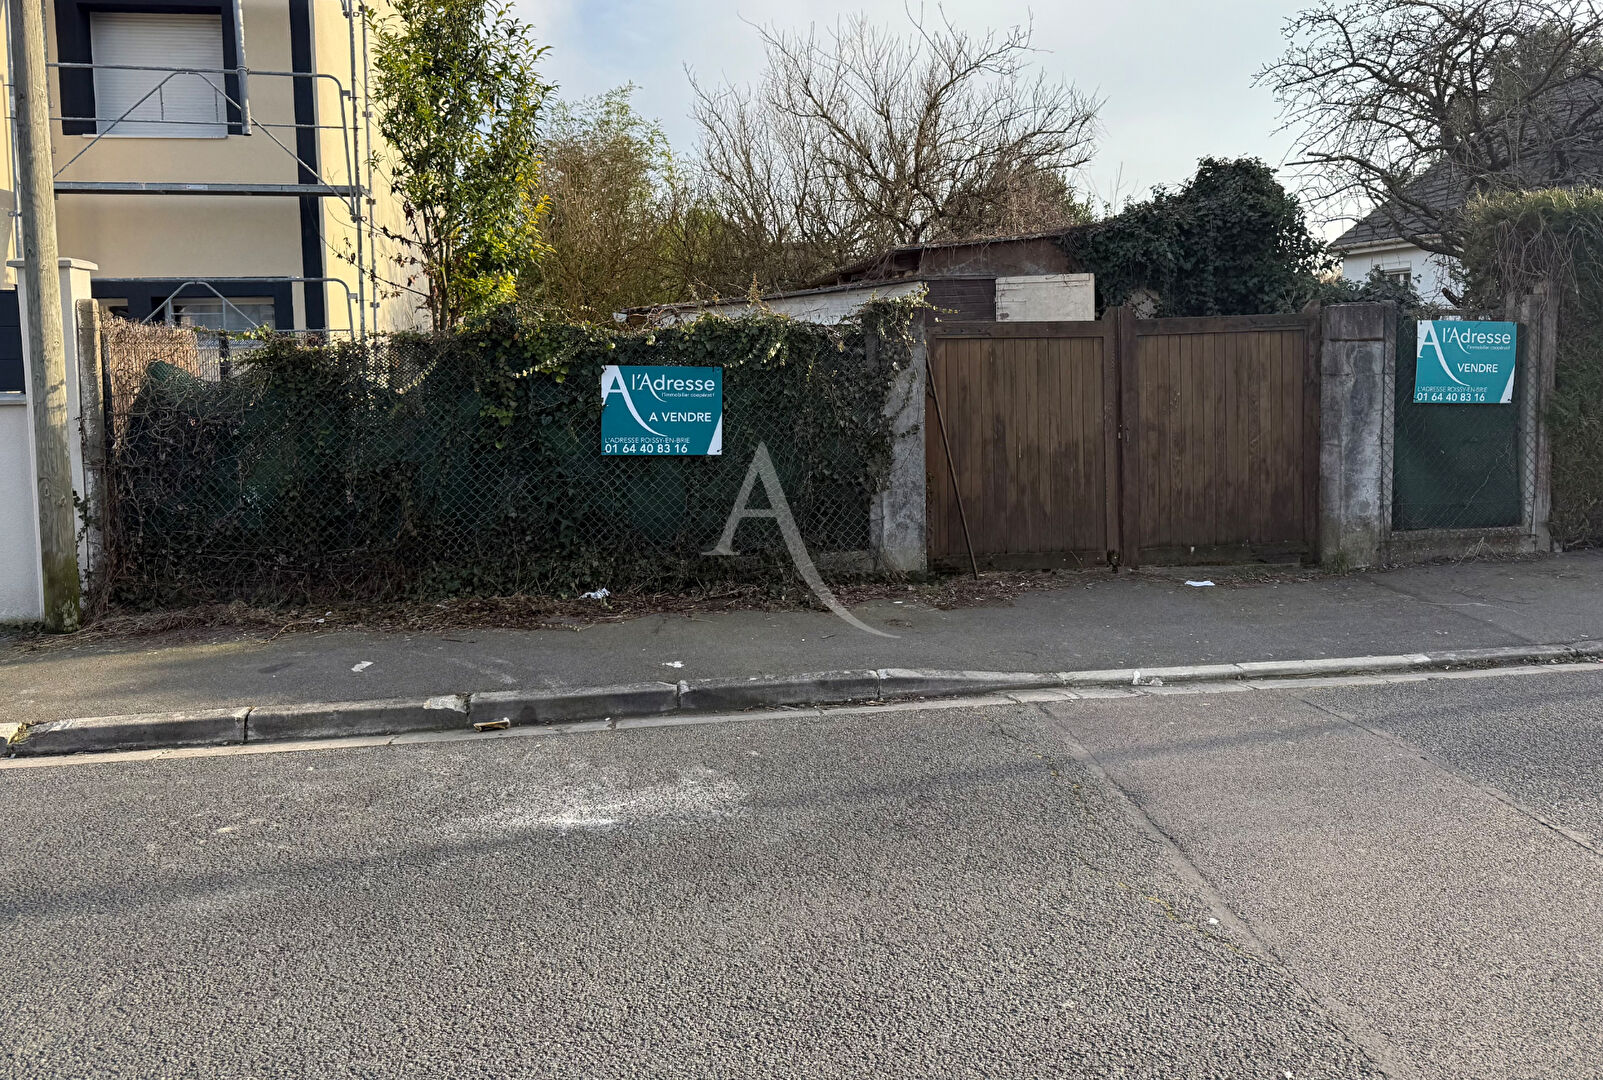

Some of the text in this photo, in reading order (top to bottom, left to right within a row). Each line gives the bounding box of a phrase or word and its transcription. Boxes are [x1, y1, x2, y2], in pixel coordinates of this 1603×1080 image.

[1443, 327, 1511, 354] l'Adresse
[1457, 363, 1499, 373] VENDRE
[632, 373, 715, 402] l'Adresse
[1417, 392, 1485, 401] 01 64 40 83 16
[649, 412, 712, 422] A VENDRE
[605, 444, 688, 453] 01 64 40 83 16
